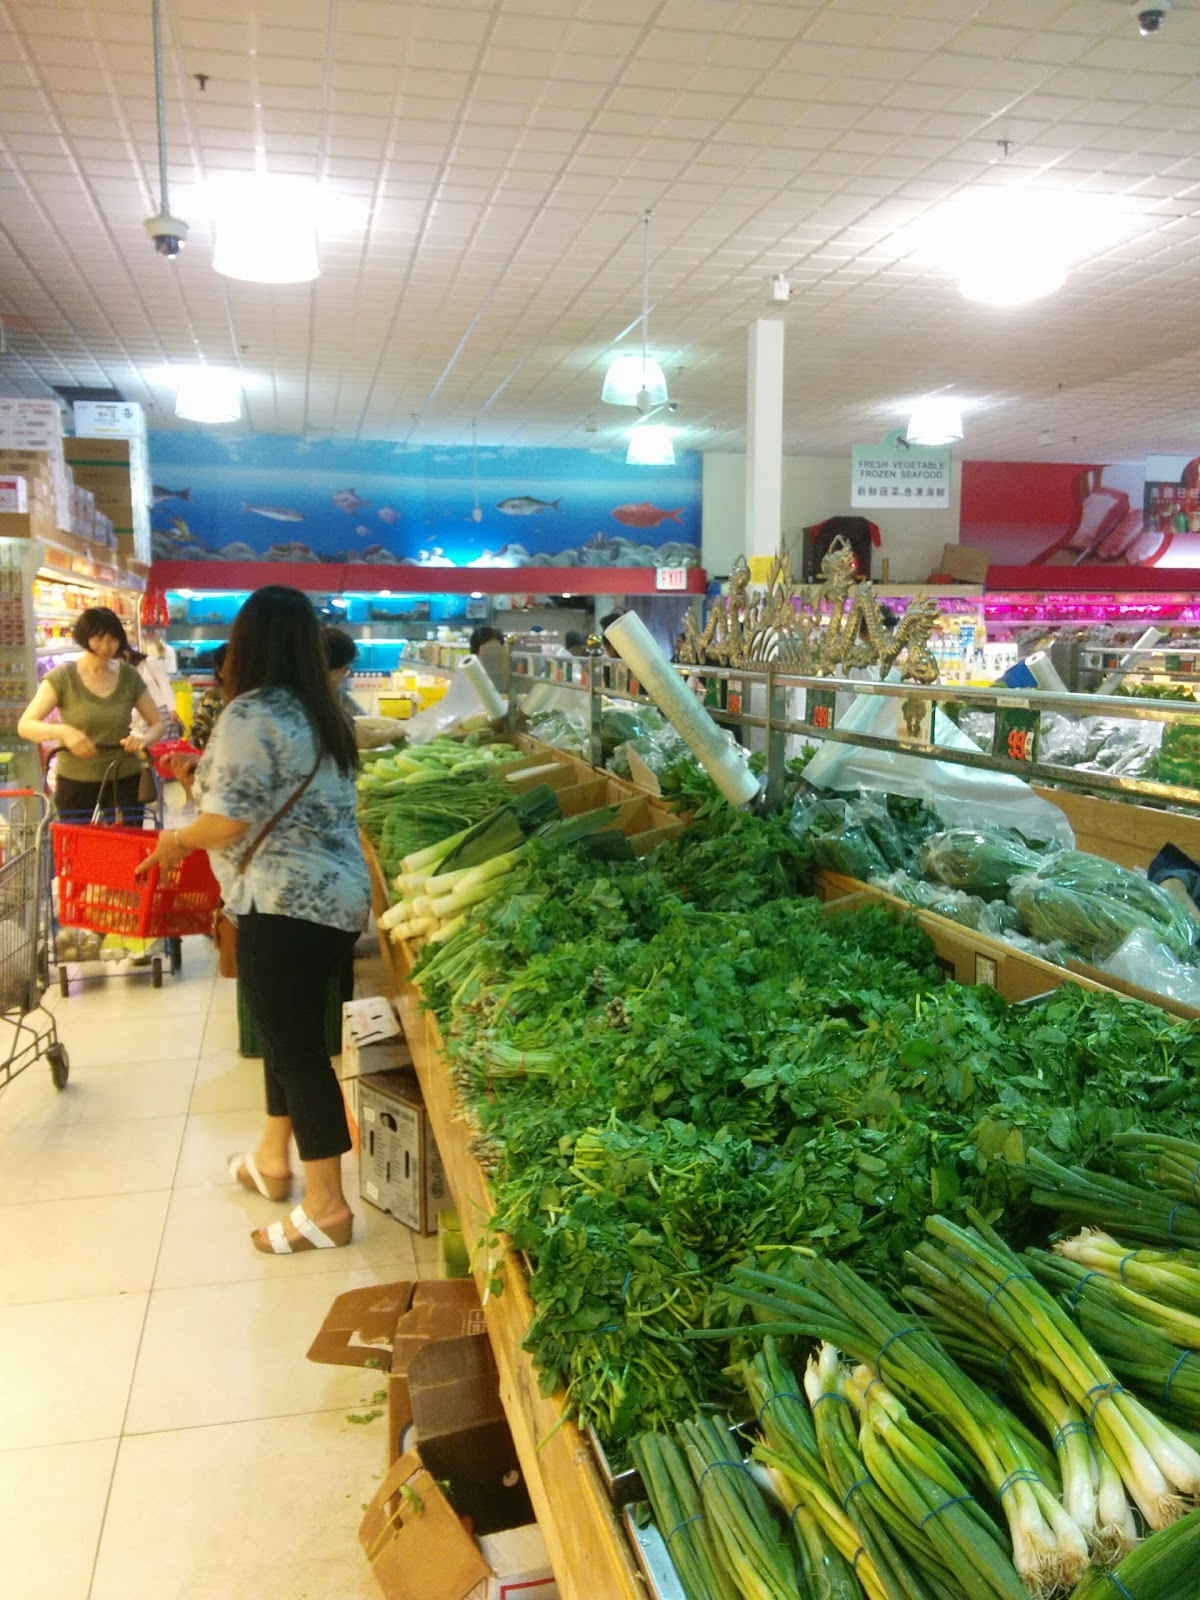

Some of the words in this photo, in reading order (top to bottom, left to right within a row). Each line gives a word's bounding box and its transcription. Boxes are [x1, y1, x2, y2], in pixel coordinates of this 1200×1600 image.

[858, 460, 888, 469] FRESH
[893, 460, 945, 470] VEGETABLE
[860, 469, 896, 479] FROZEN
[900, 470, 943, 479] SEAFOOD
[662, 570, 683, 588] EXIT
